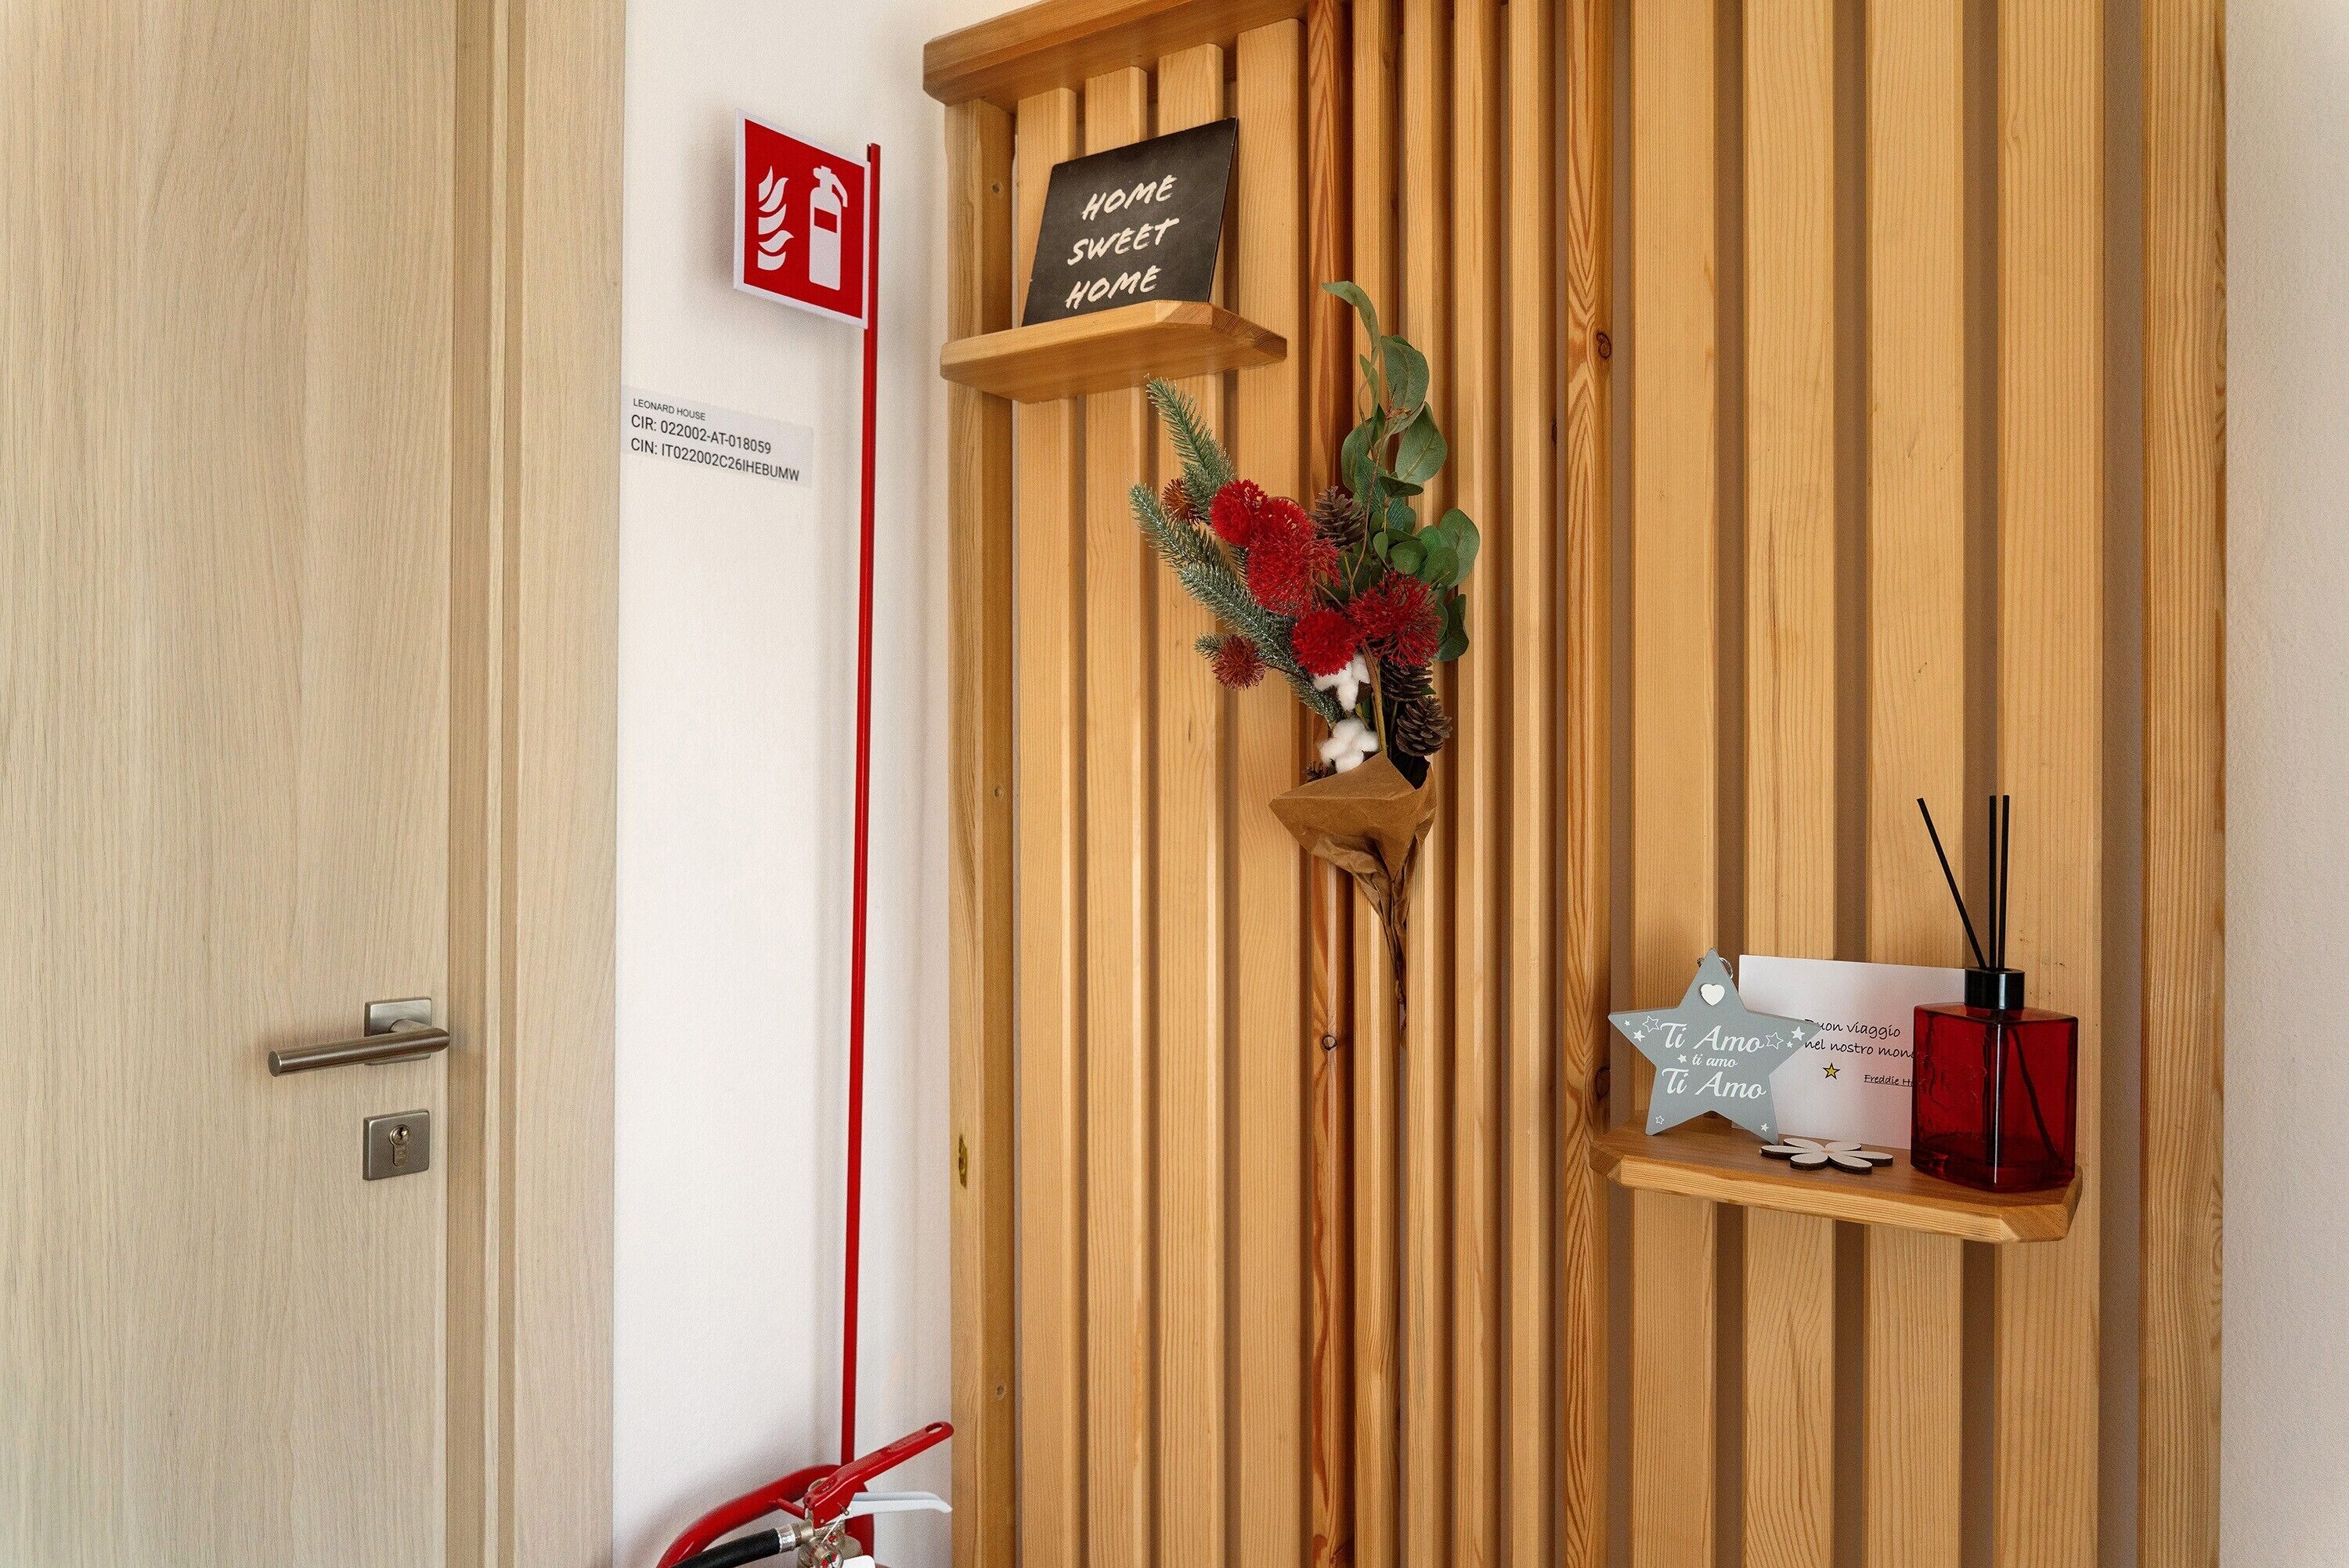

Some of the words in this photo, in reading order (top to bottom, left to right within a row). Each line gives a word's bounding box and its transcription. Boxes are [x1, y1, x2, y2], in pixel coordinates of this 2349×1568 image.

[1081, 174, 1177, 221] HOME
[1066, 217, 1180, 266] SWEET
[1064, 265, 1162, 310] HOME
[633, 398, 675, 414] LEONARD
[677, 407, 706, 421] HOUSE
[631, 414, 657, 431] CIR:
[660, 420, 772, 454] 022002-AT-018059
[630, 438, 658, 455] CIN:
[662, 443, 800, 481] IT022002C26IHEBUMW
[1660, 1022, 1688, 1049] Ti
[1693, 1025, 1765, 1053] Amo
[1804, 1018, 1843, 1032] uon
[1846, 1022, 1901, 1040] viaggio
[1691, 1054, 1703, 1065] ti
[1705, 1058, 1738, 1068] amo
[1805, 1039, 1826, 1051] nel
[1830, 1041, 1874, 1055] nostro
[1662, 1068, 1690, 1094] Ti
[1694, 1071, 1766, 1099] Amo
[1864, 1074, 1900, 1086] Freddie
